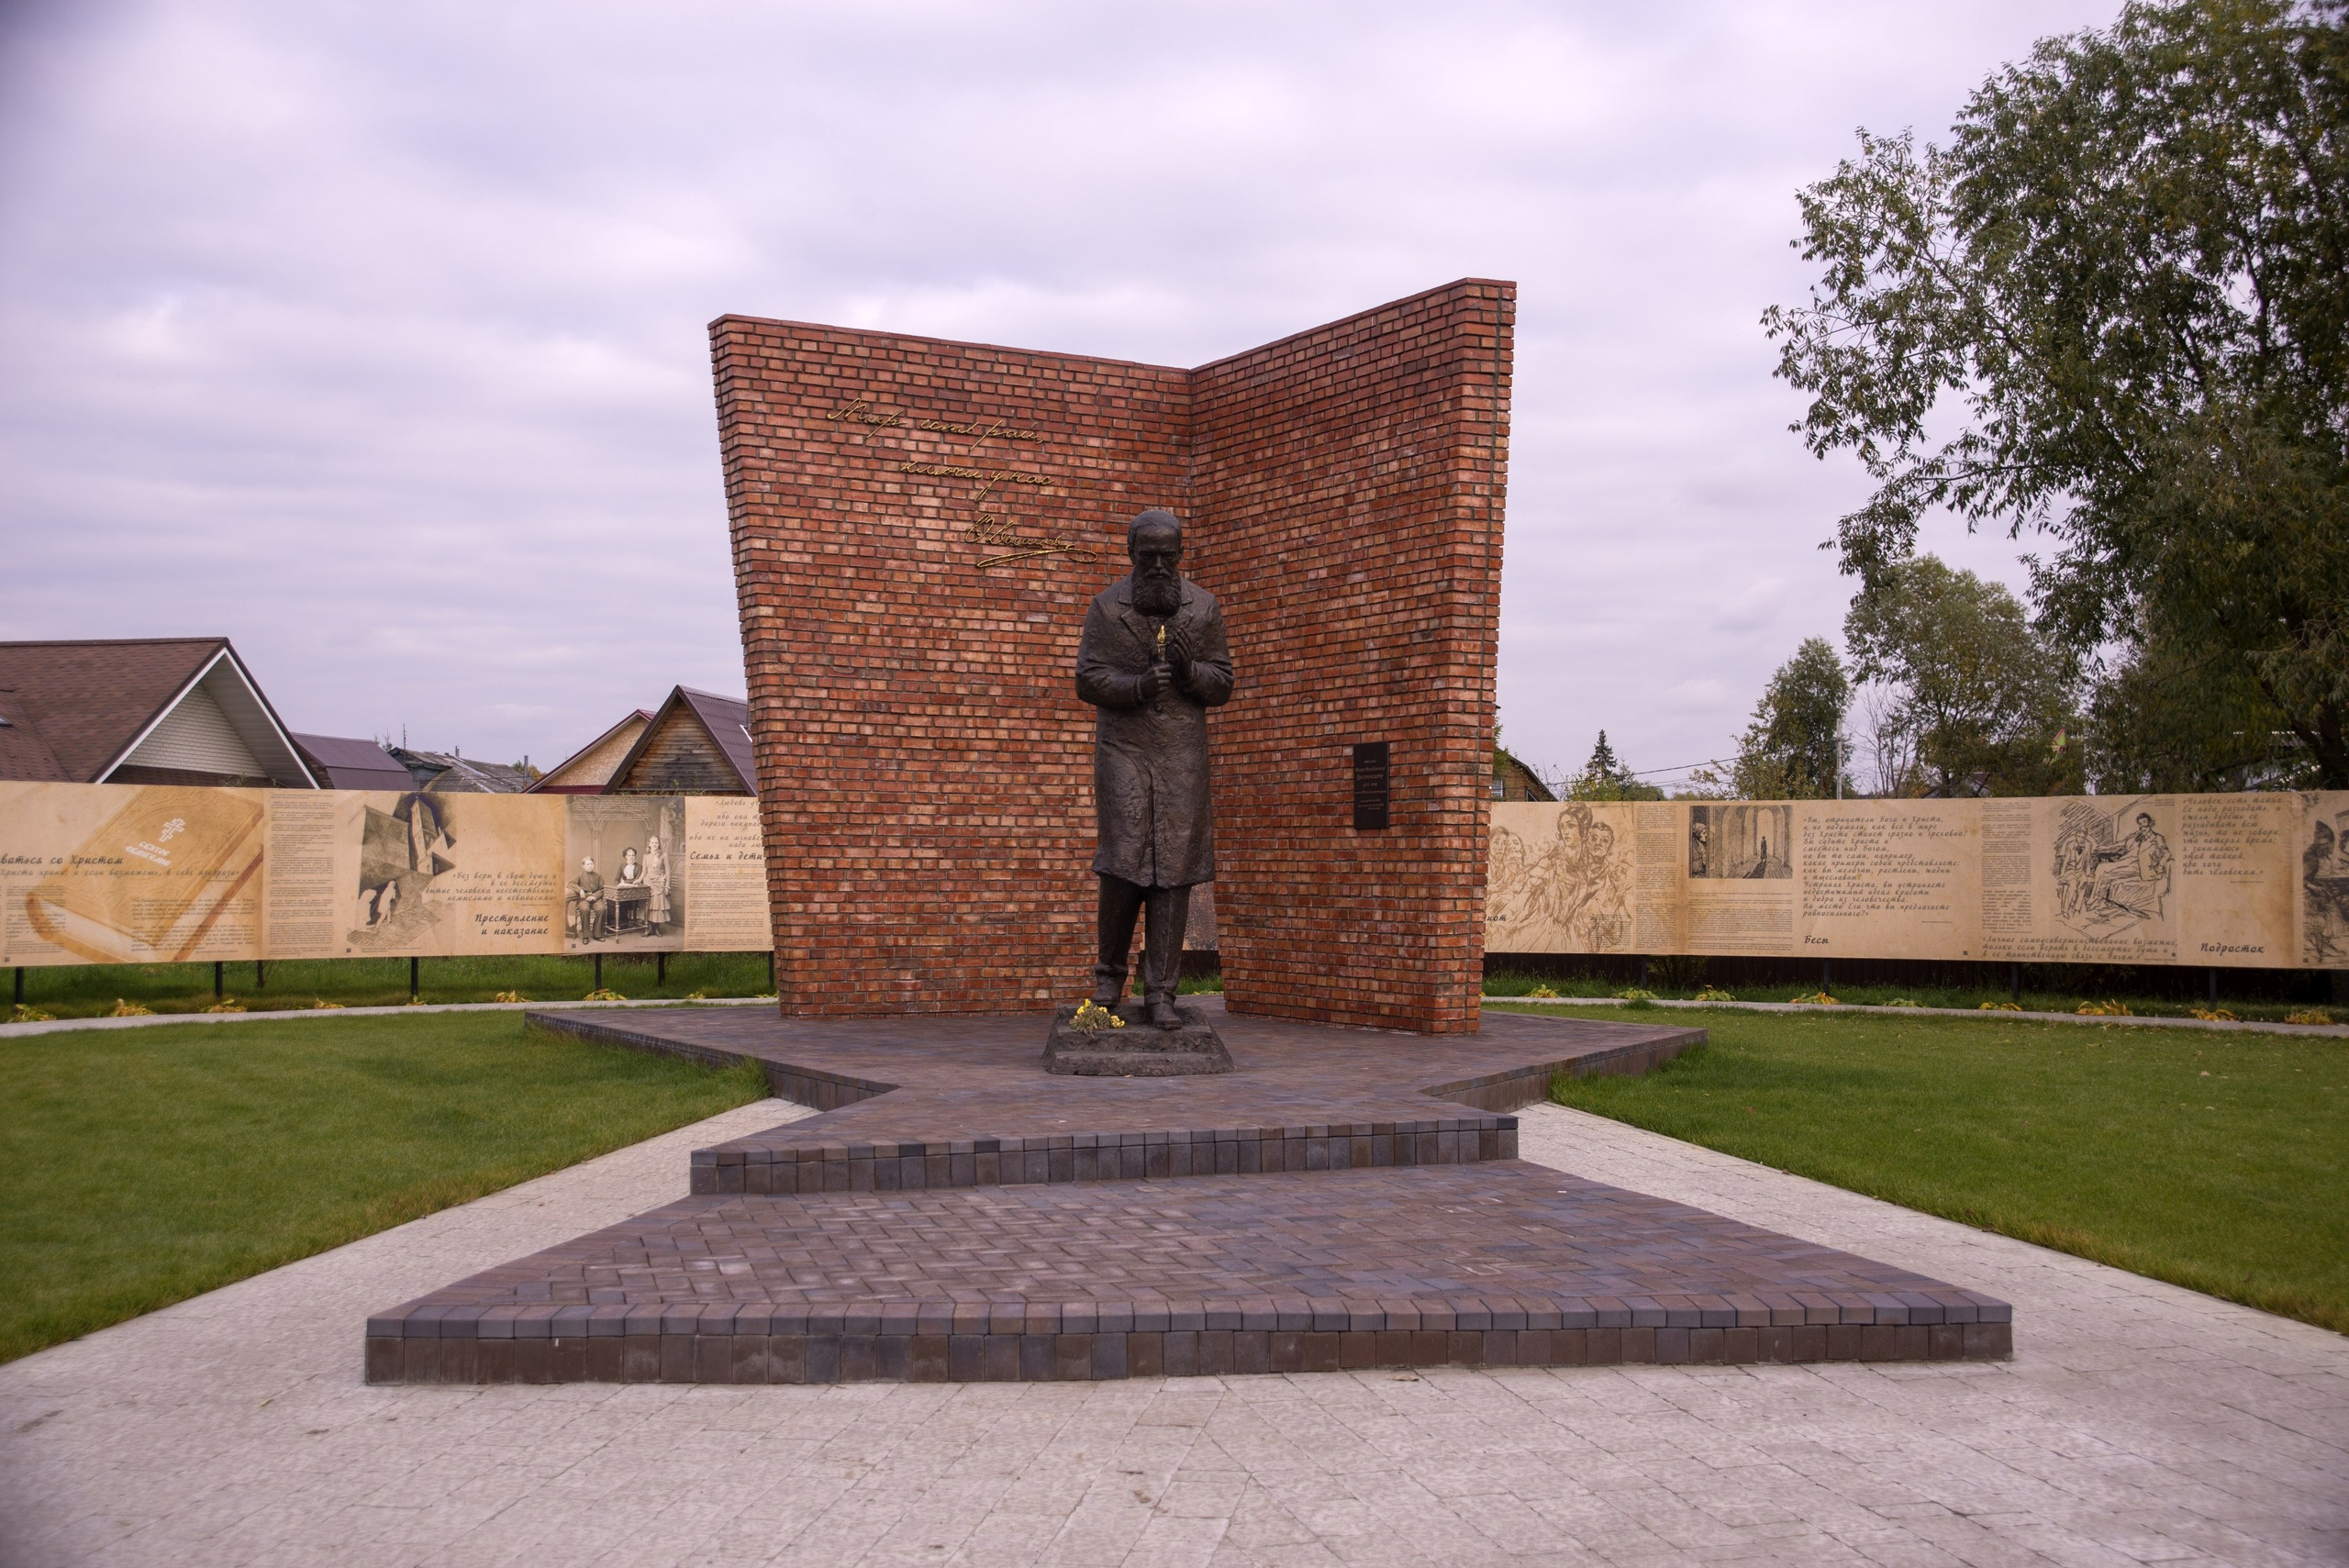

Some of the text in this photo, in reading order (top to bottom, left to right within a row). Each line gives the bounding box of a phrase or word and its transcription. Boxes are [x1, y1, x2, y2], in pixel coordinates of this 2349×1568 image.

[826, 397, 907, 439] Мир
[919, 418, 979, 435] есть
[900, 461, 1055, 503] ключи у нас
[2183, 795, 2221, 805] «Человек
[717, 811, 729, 819] ибо
[2221, 805, 2269, 815] разгадать,
[1826, 817, 1874, 826] отрицатели
[1912, 816, 1943, 825] Христа,
[2213, 811, 2243, 822] будешь
[701, 819, 726, 828] дорого
[2181, 819, 2258, 831] разгадывать всю
[689, 832, 702, 840] ибо
[1820, 831, 1848, 840] Христа
[1929, 829, 1967, 839] греховно?
[2183, 830, 2210, 839] жизнь,
[2249, 828, 2281, 838] говори,
[1819, 838, 1845, 846] судите
[1851, 838, 1879, 846] Христа
[690, 851, 719, 860] Семья
[739, 851, 763, 860] дети
[2194, 846, 2239, 855] занимаюсь
[71, 854, 123, 868] Христом
[1898, 860, 1960, 868] представляете:
[2203, 862, 2221, 871] хочу
[0, 869, 34, 878] Христа
[453, 873, 469, 881] «Без
[474, 872, 492, 881] веры
[529, 871, 549, 881] душу
[512, 878, 558, 888] бессмертие
[1813, 895, 1833, 904] добра
[1899, 904, 1950, 912] предлагаете
[1802, 910, 1869, 918] равносильного?»
[474, 914, 550, 926] Преступление
[494, 928, 550, 939] наказание
[1805, 935, 1829, 944] Бесы
[2040, 943, 2068, 951] верить
[2083, 945, 2132, 953] бессмертие
[2136, 946, 2157, 956] души
[2200, 941, 2266, 956] Подросток
[2006, 951, 2066, 960] таинственную
[2072, 951, 2092, 962] связь
